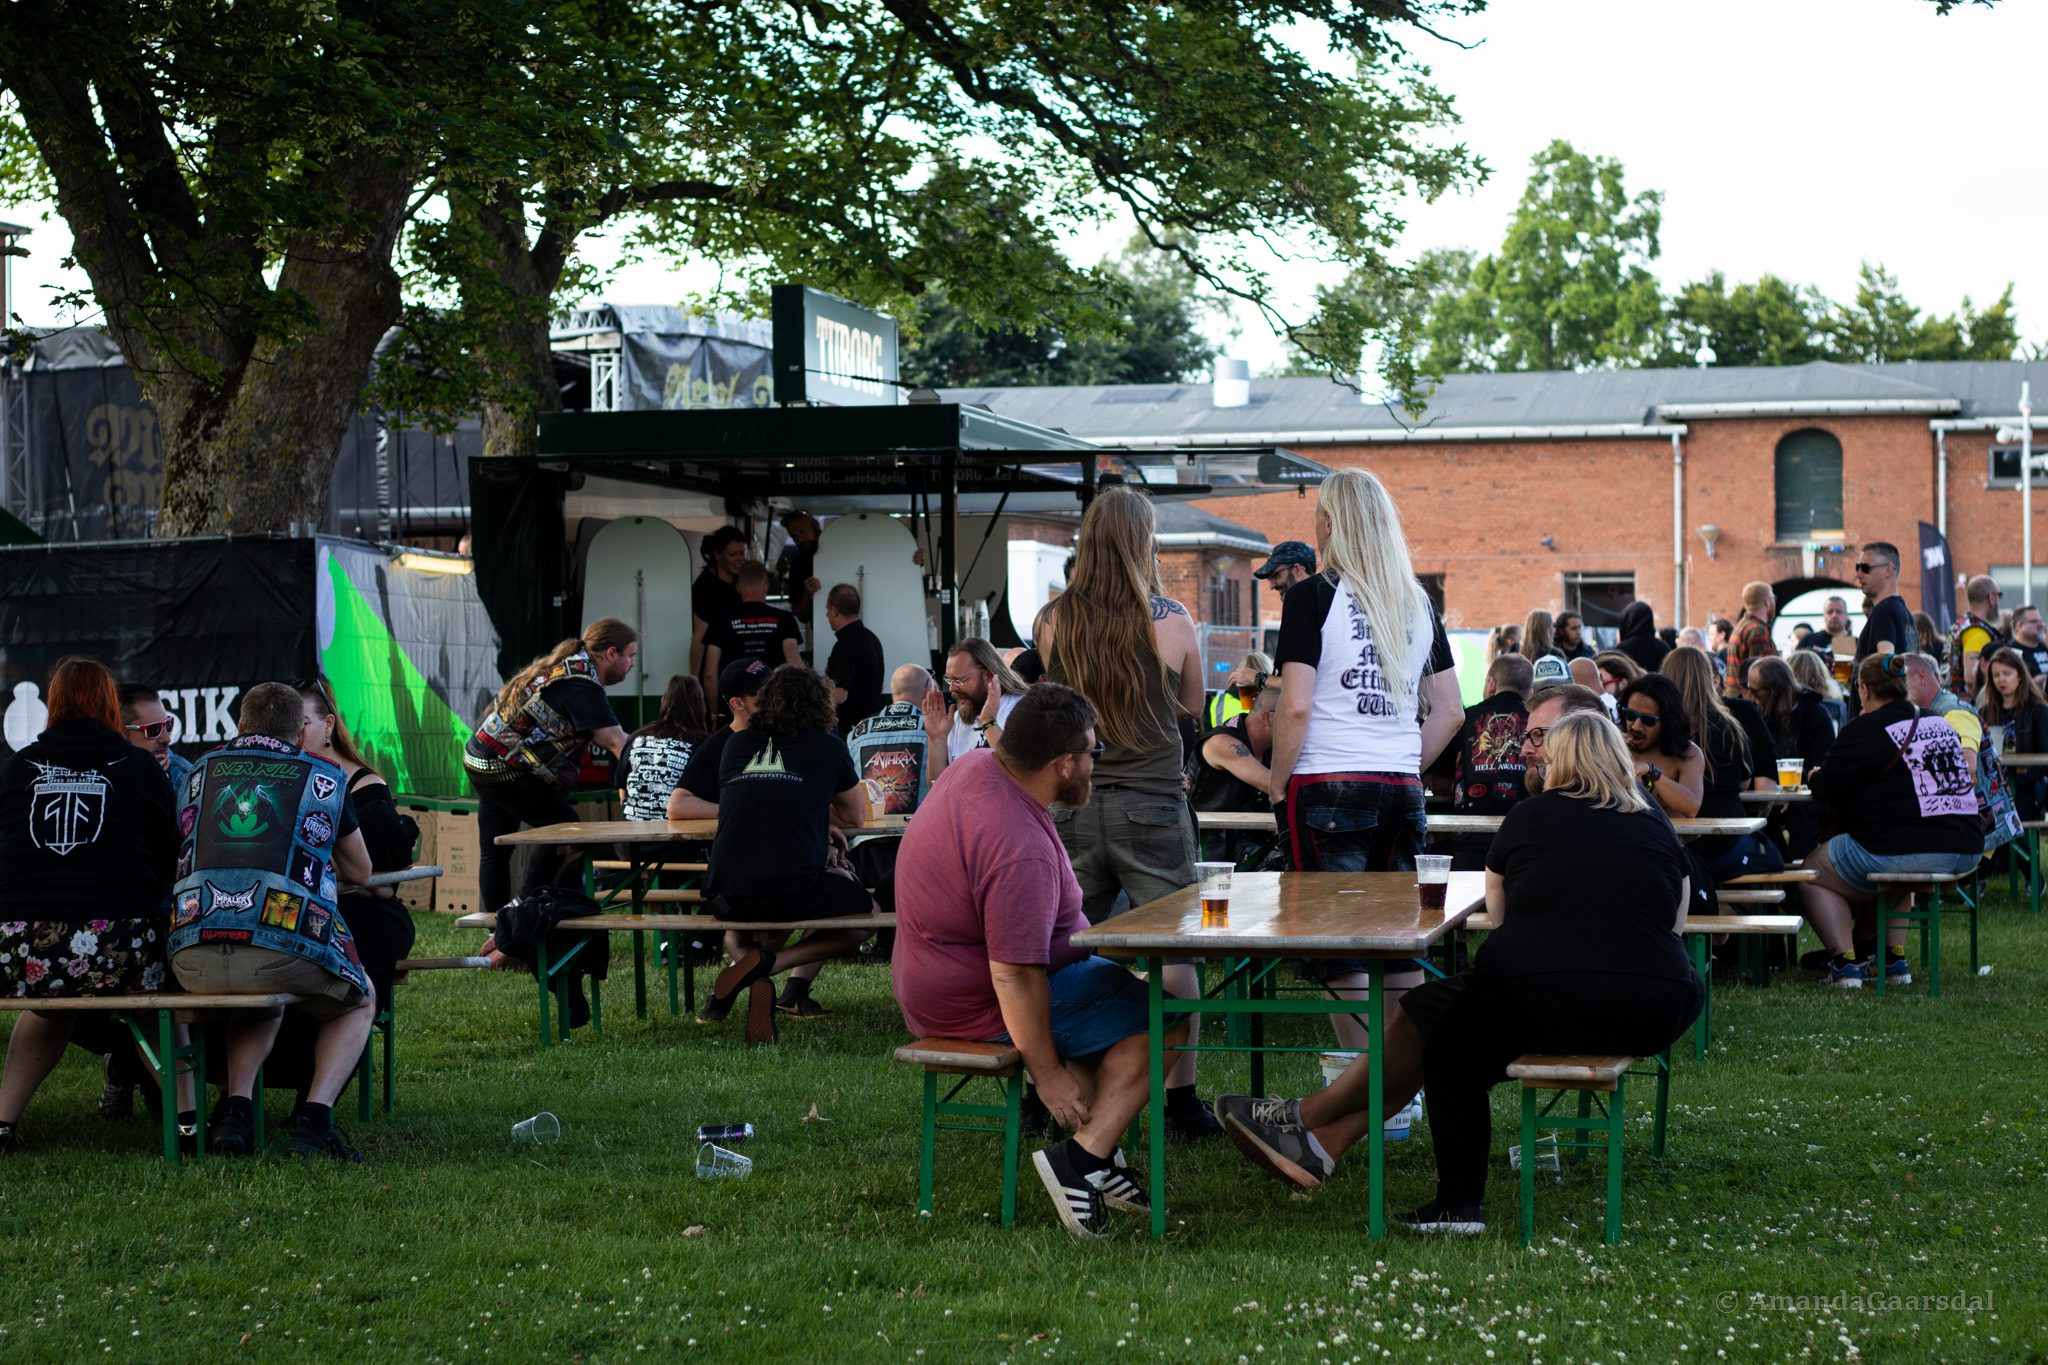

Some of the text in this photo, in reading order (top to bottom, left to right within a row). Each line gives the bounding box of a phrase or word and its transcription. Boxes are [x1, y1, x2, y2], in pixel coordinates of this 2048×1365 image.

[816, 315, 884, 398] TUBORG
[778, 470, 830, 484] TUBORG
[929, 470, 982, 484] TORG
[157, 686, 240, 746] SIK
[865, 748, 917, 768] ANTHRAX
[204, 881, 260, 917] IMPALERS
